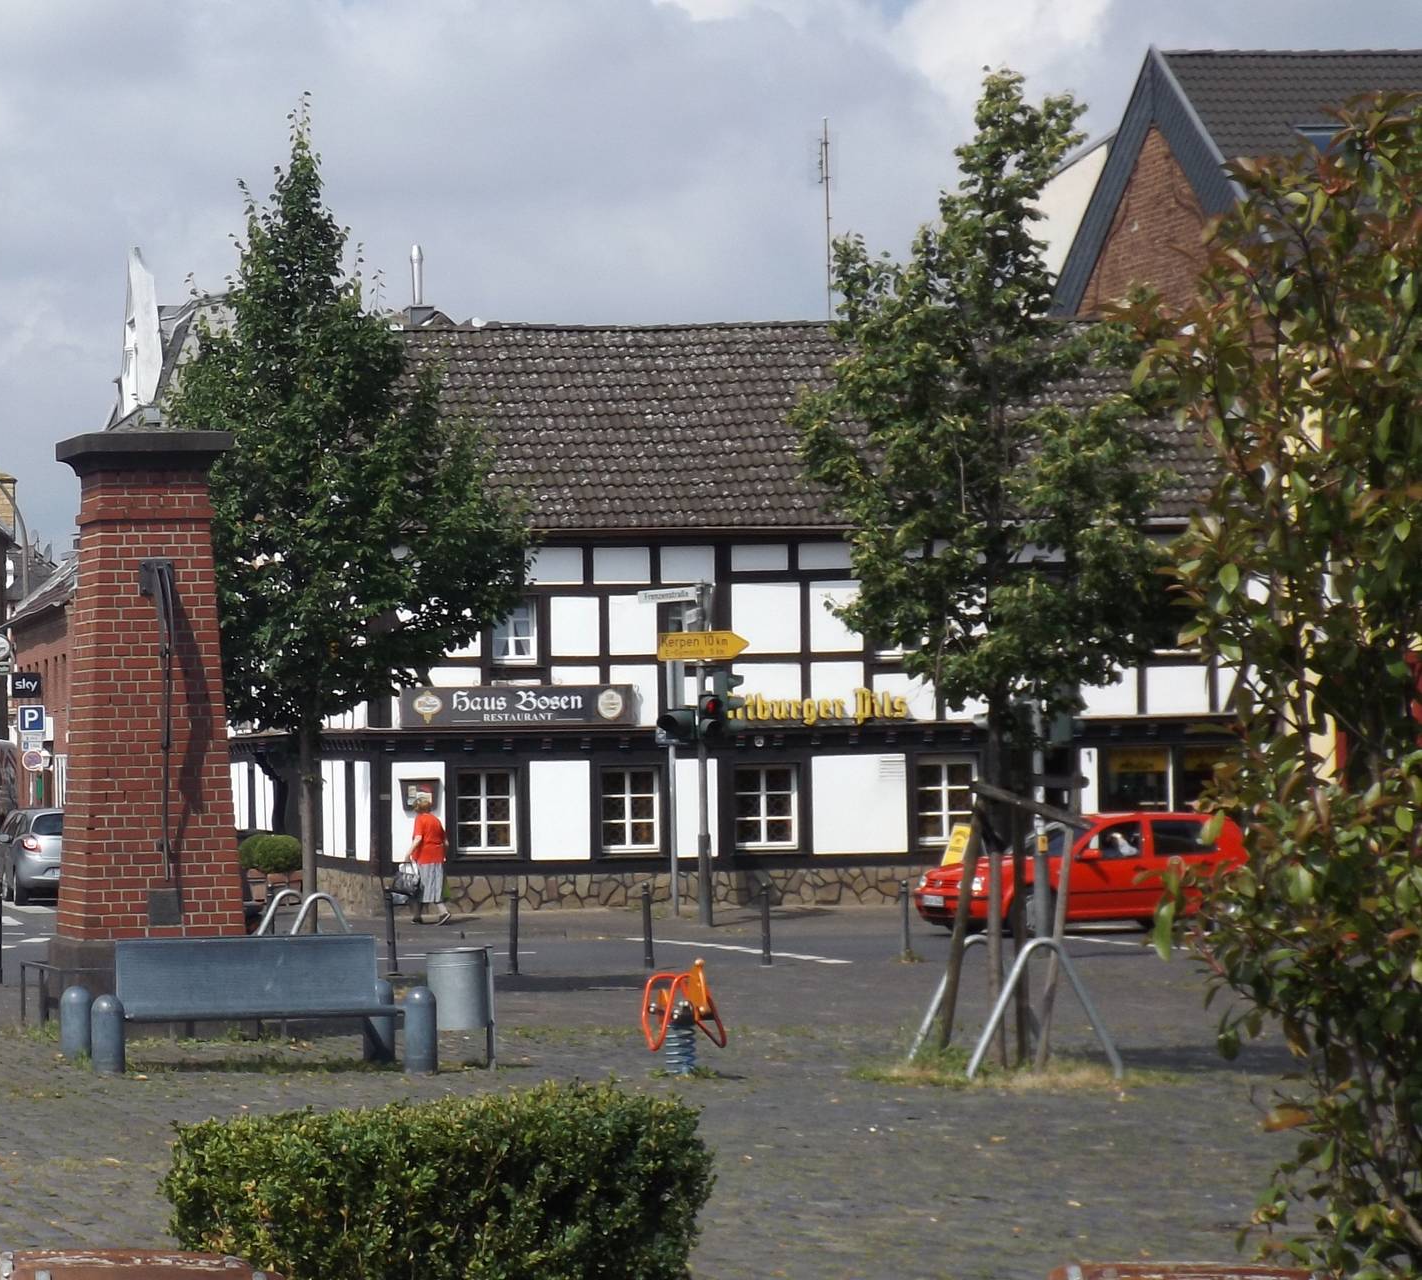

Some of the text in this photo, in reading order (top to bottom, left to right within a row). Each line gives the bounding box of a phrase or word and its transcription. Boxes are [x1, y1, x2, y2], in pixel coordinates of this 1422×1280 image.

[661, 635, 729, 648] Kerpen 10 km
[14, 678, 38, 692] sky
[451, 690, 508, 712] Haus
[514, 690, 584, 712] Bosen
[727, 687, 908, 726] tburger Pils
[24, 709, 39, 729] P
[482, 712, 554, 722] RESTAURANT
